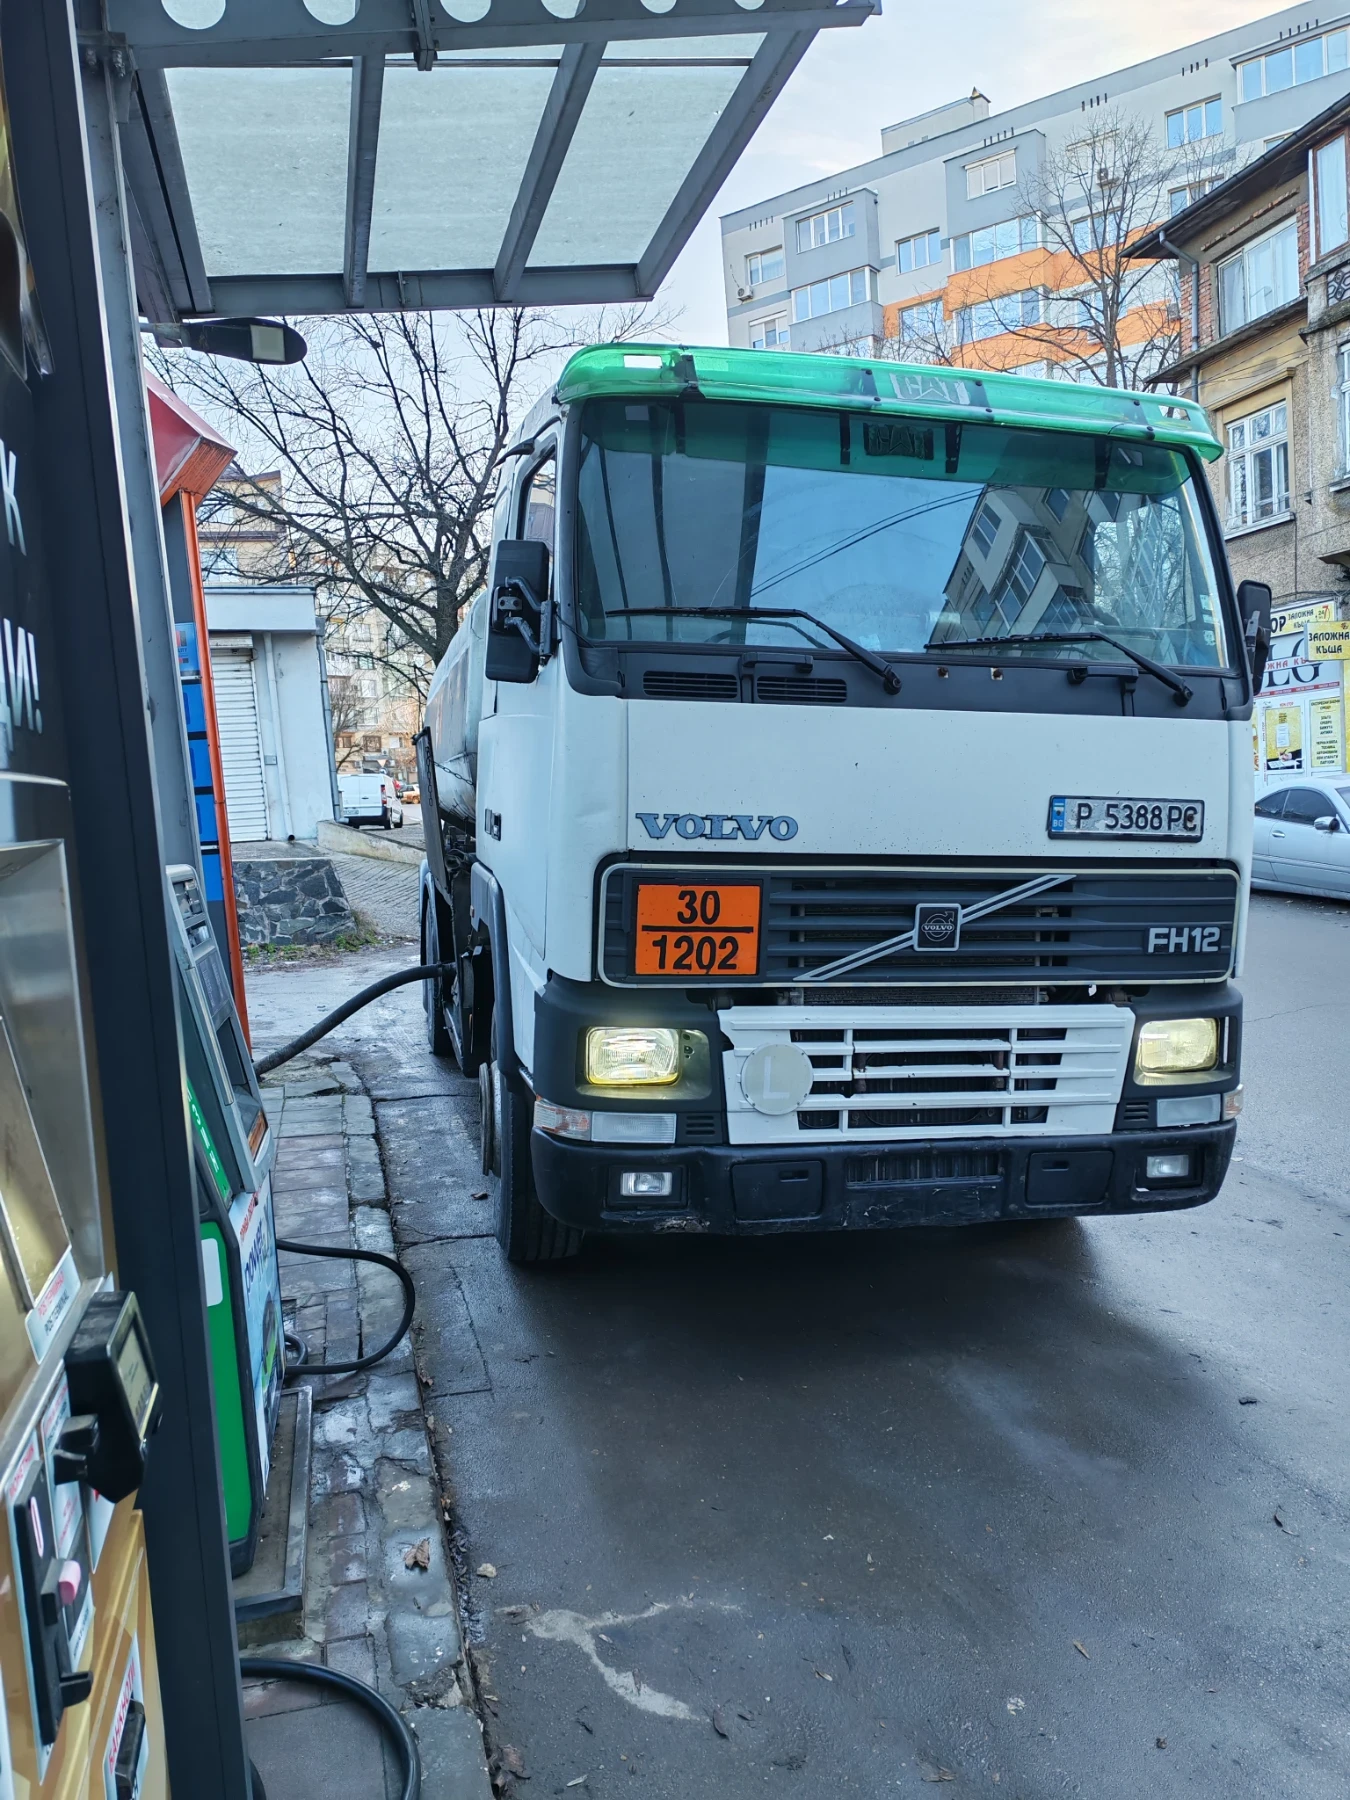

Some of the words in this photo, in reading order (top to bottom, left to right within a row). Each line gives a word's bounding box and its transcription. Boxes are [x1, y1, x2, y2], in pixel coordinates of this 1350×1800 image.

[1308, 630, 1350, 642] ЗАЛОЖНА
[635, 813, 799, 841] VOLVO
[1105, 804, 1163, 830] 5388
[677, 890, 720, 925] 30
[1148, 926, 1221, 953] FH12
[652, 934, 739, 973] 1202
